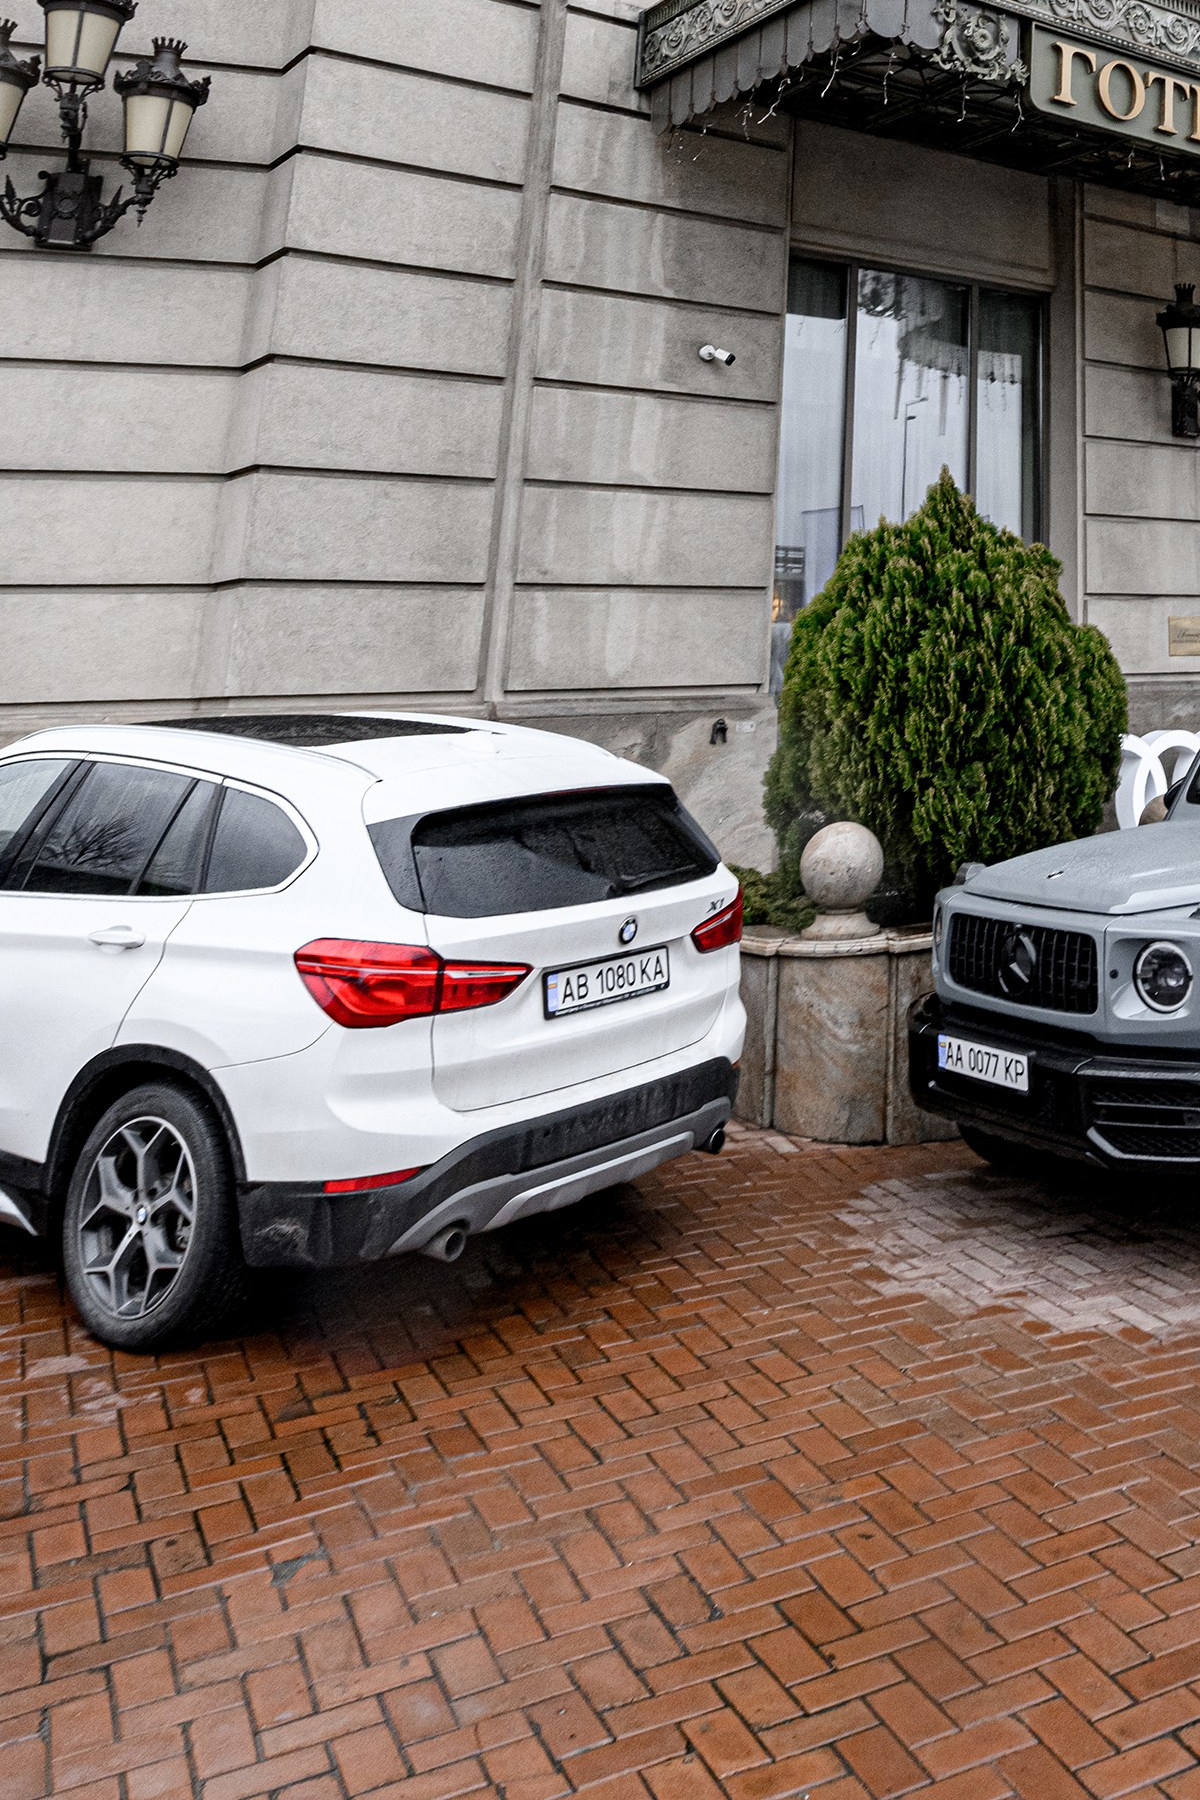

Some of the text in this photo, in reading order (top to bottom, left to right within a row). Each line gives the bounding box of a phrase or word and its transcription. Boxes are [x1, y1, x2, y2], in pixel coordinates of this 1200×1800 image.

[706, 897, 725, 913] X1
[561, 954, 665, 1004] AB 1080 KA
[946, 1041, 1025, 1083] AA 0077 KP
